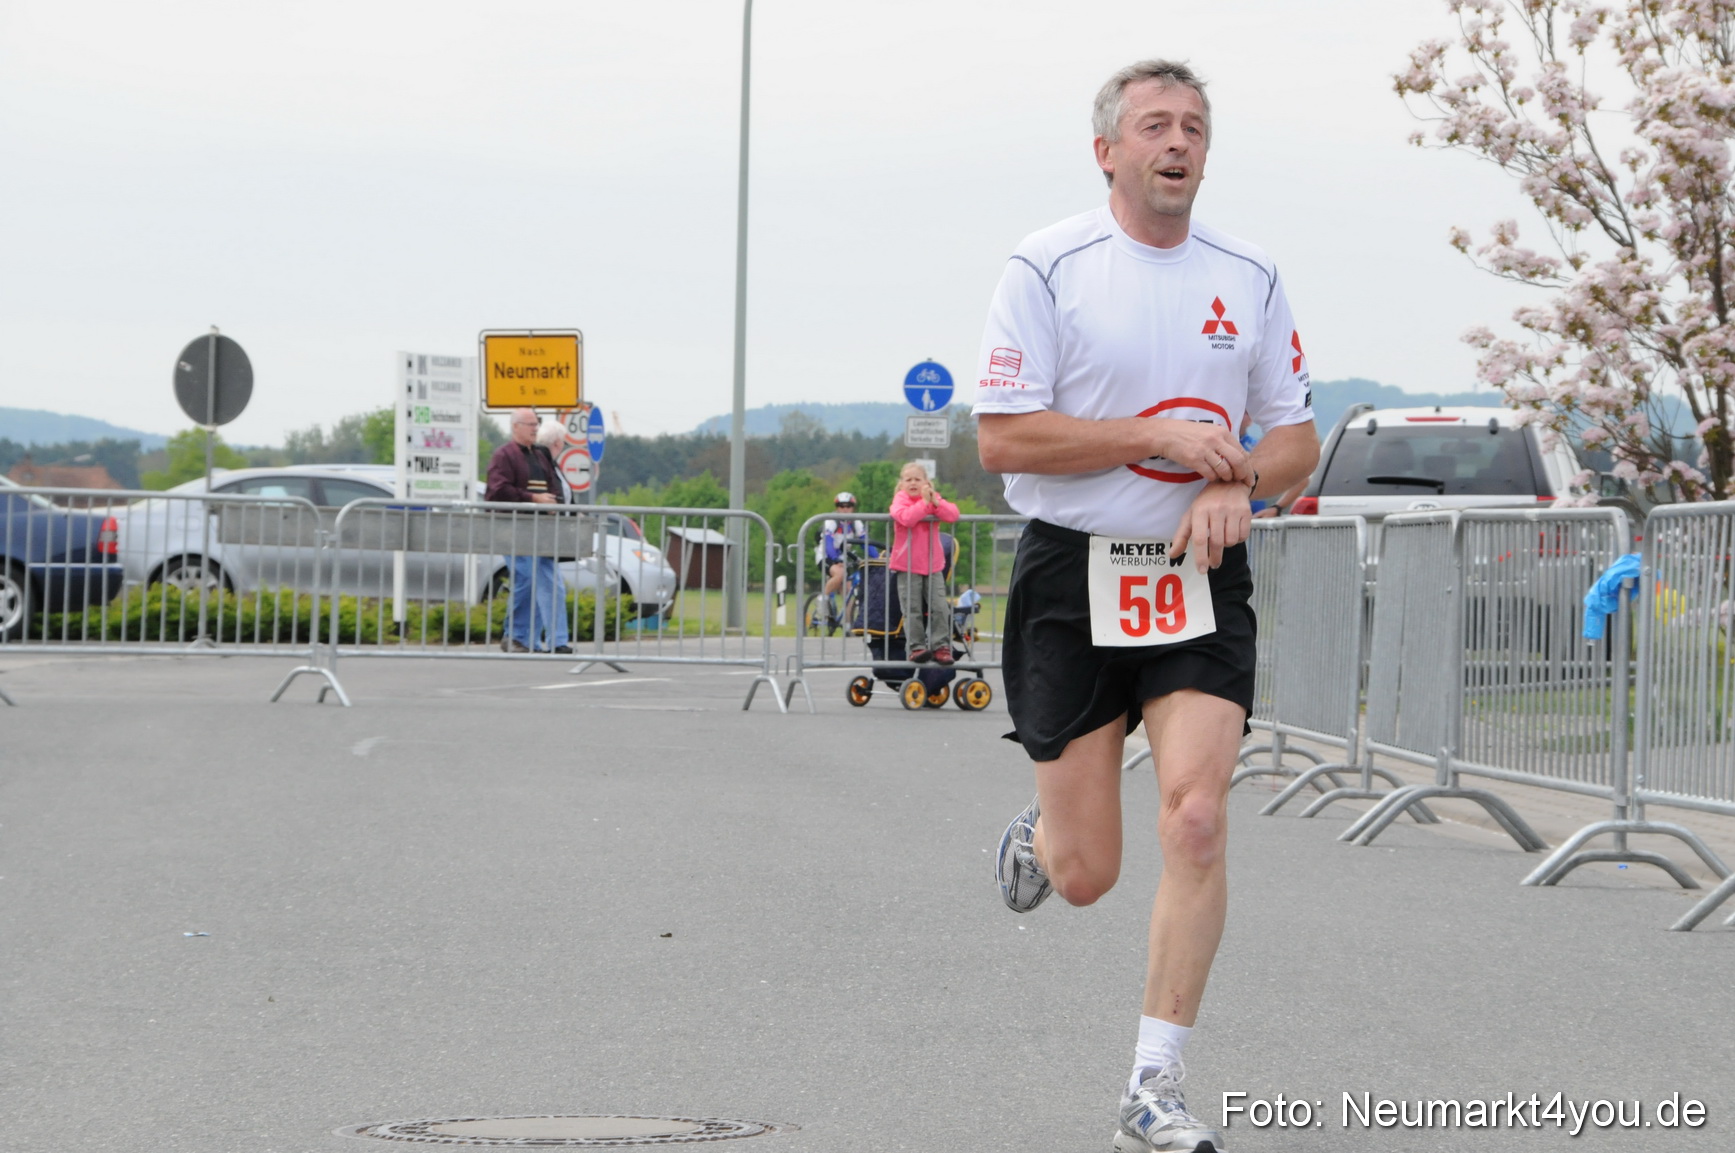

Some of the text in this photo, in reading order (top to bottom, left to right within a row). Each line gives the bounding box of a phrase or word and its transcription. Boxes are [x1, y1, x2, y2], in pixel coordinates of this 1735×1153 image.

[519, 347, 546, 356] Nach
[494, 362, 570, 379] Neumarkt
[979, 378, 1030, 389] SEAT
[520, 386, 547, 396] 5 km
[568, 415, 588, 434] 60
[1110, 543, 1166, 556] MEYER
[1110, 556, 1167, 567] WERBUNG
[1119, 573, 1187, 638] 59
